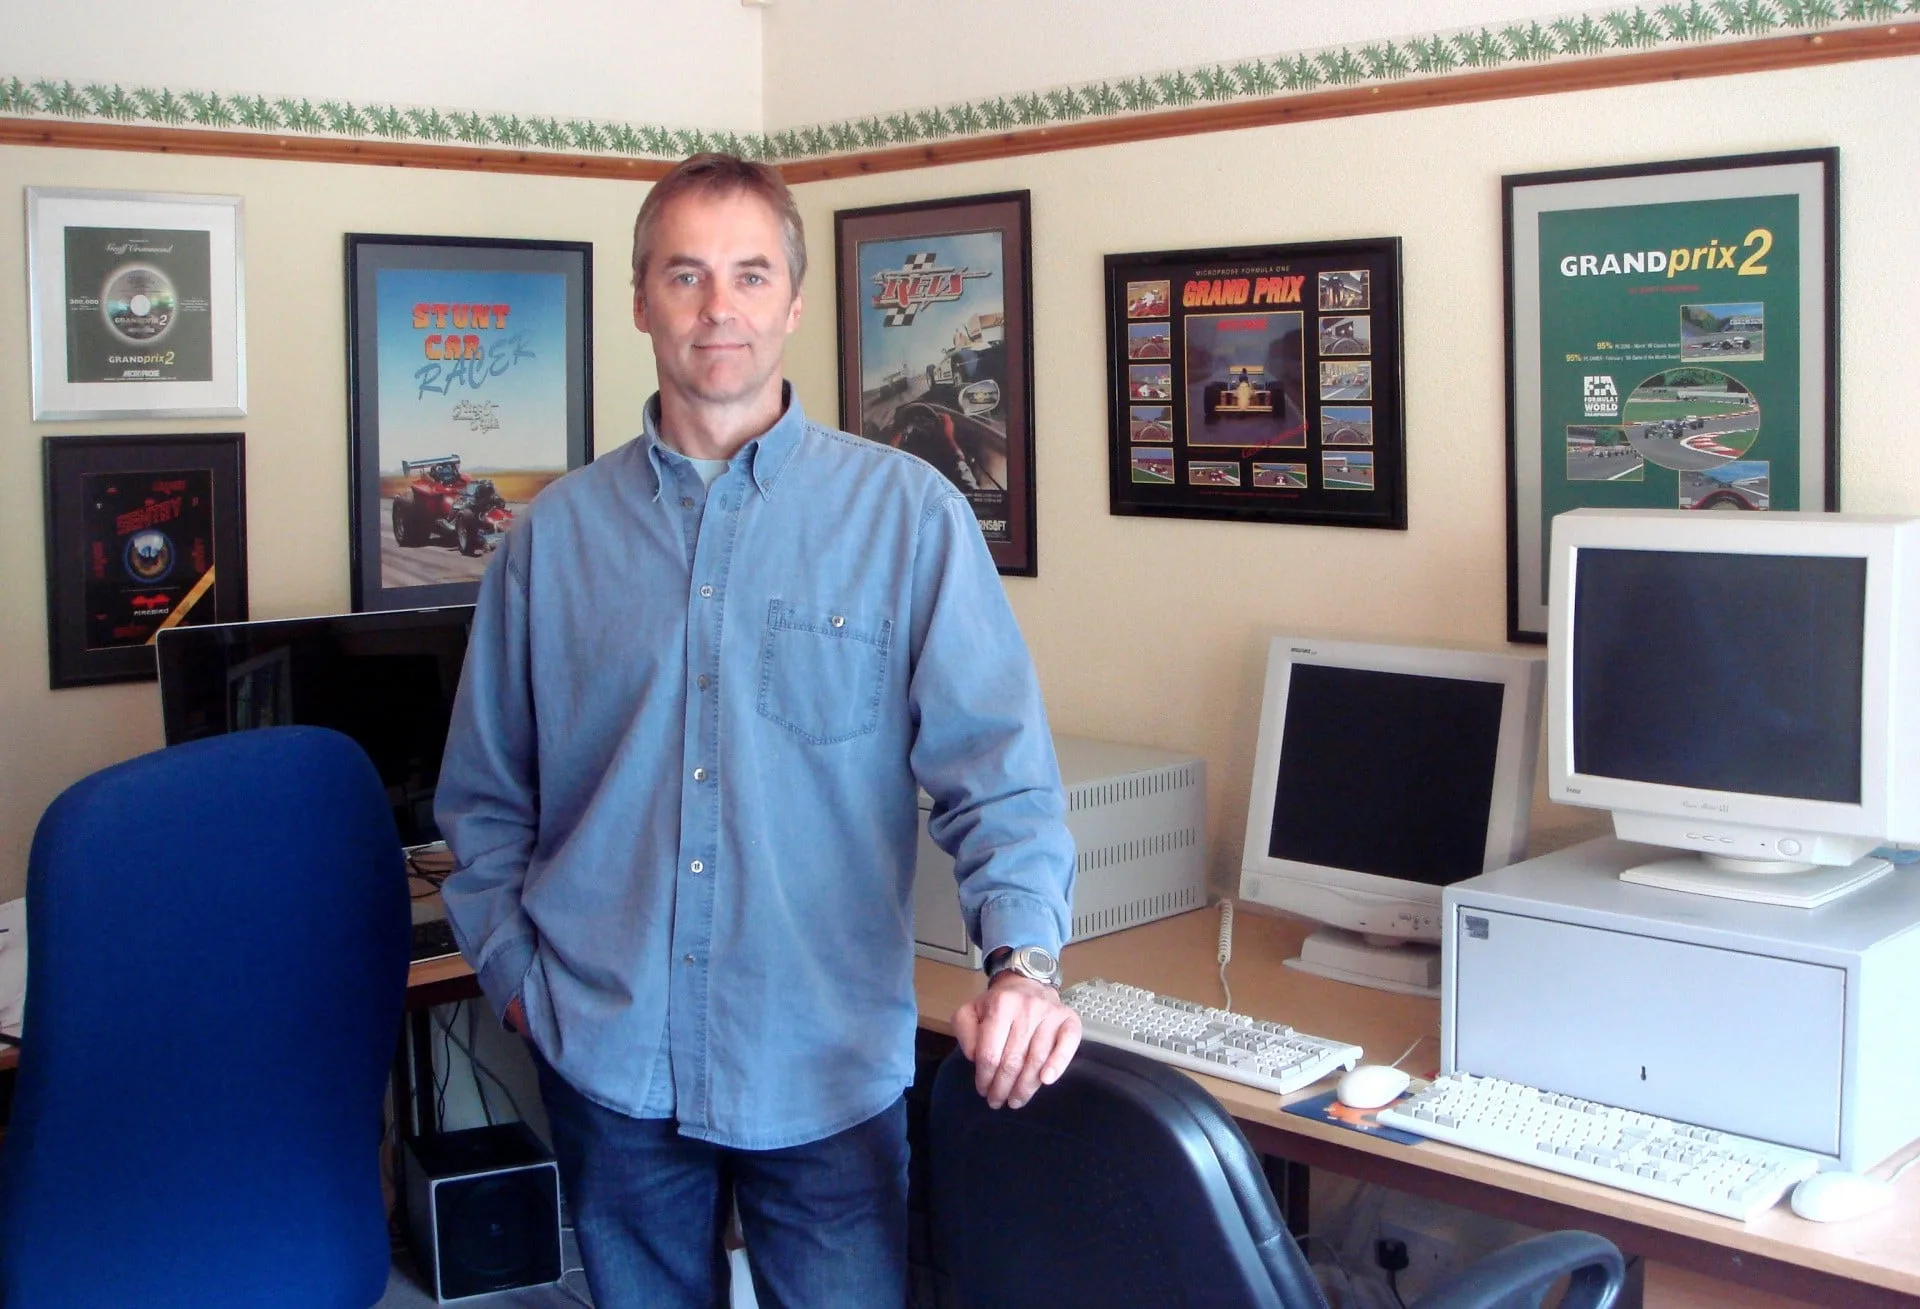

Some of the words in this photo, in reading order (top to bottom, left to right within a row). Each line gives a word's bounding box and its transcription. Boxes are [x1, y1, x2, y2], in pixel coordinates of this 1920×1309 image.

[1183, 278, 1250, 307] GRAND
[1252, 276, 1305, 304] PRIX
[412, 303, 511, 330] STUNT
[425, 334, 482, 360] CAR
[414, 330, 537, 400] RACER
[1585, 403, 1618, 411] WORLD
